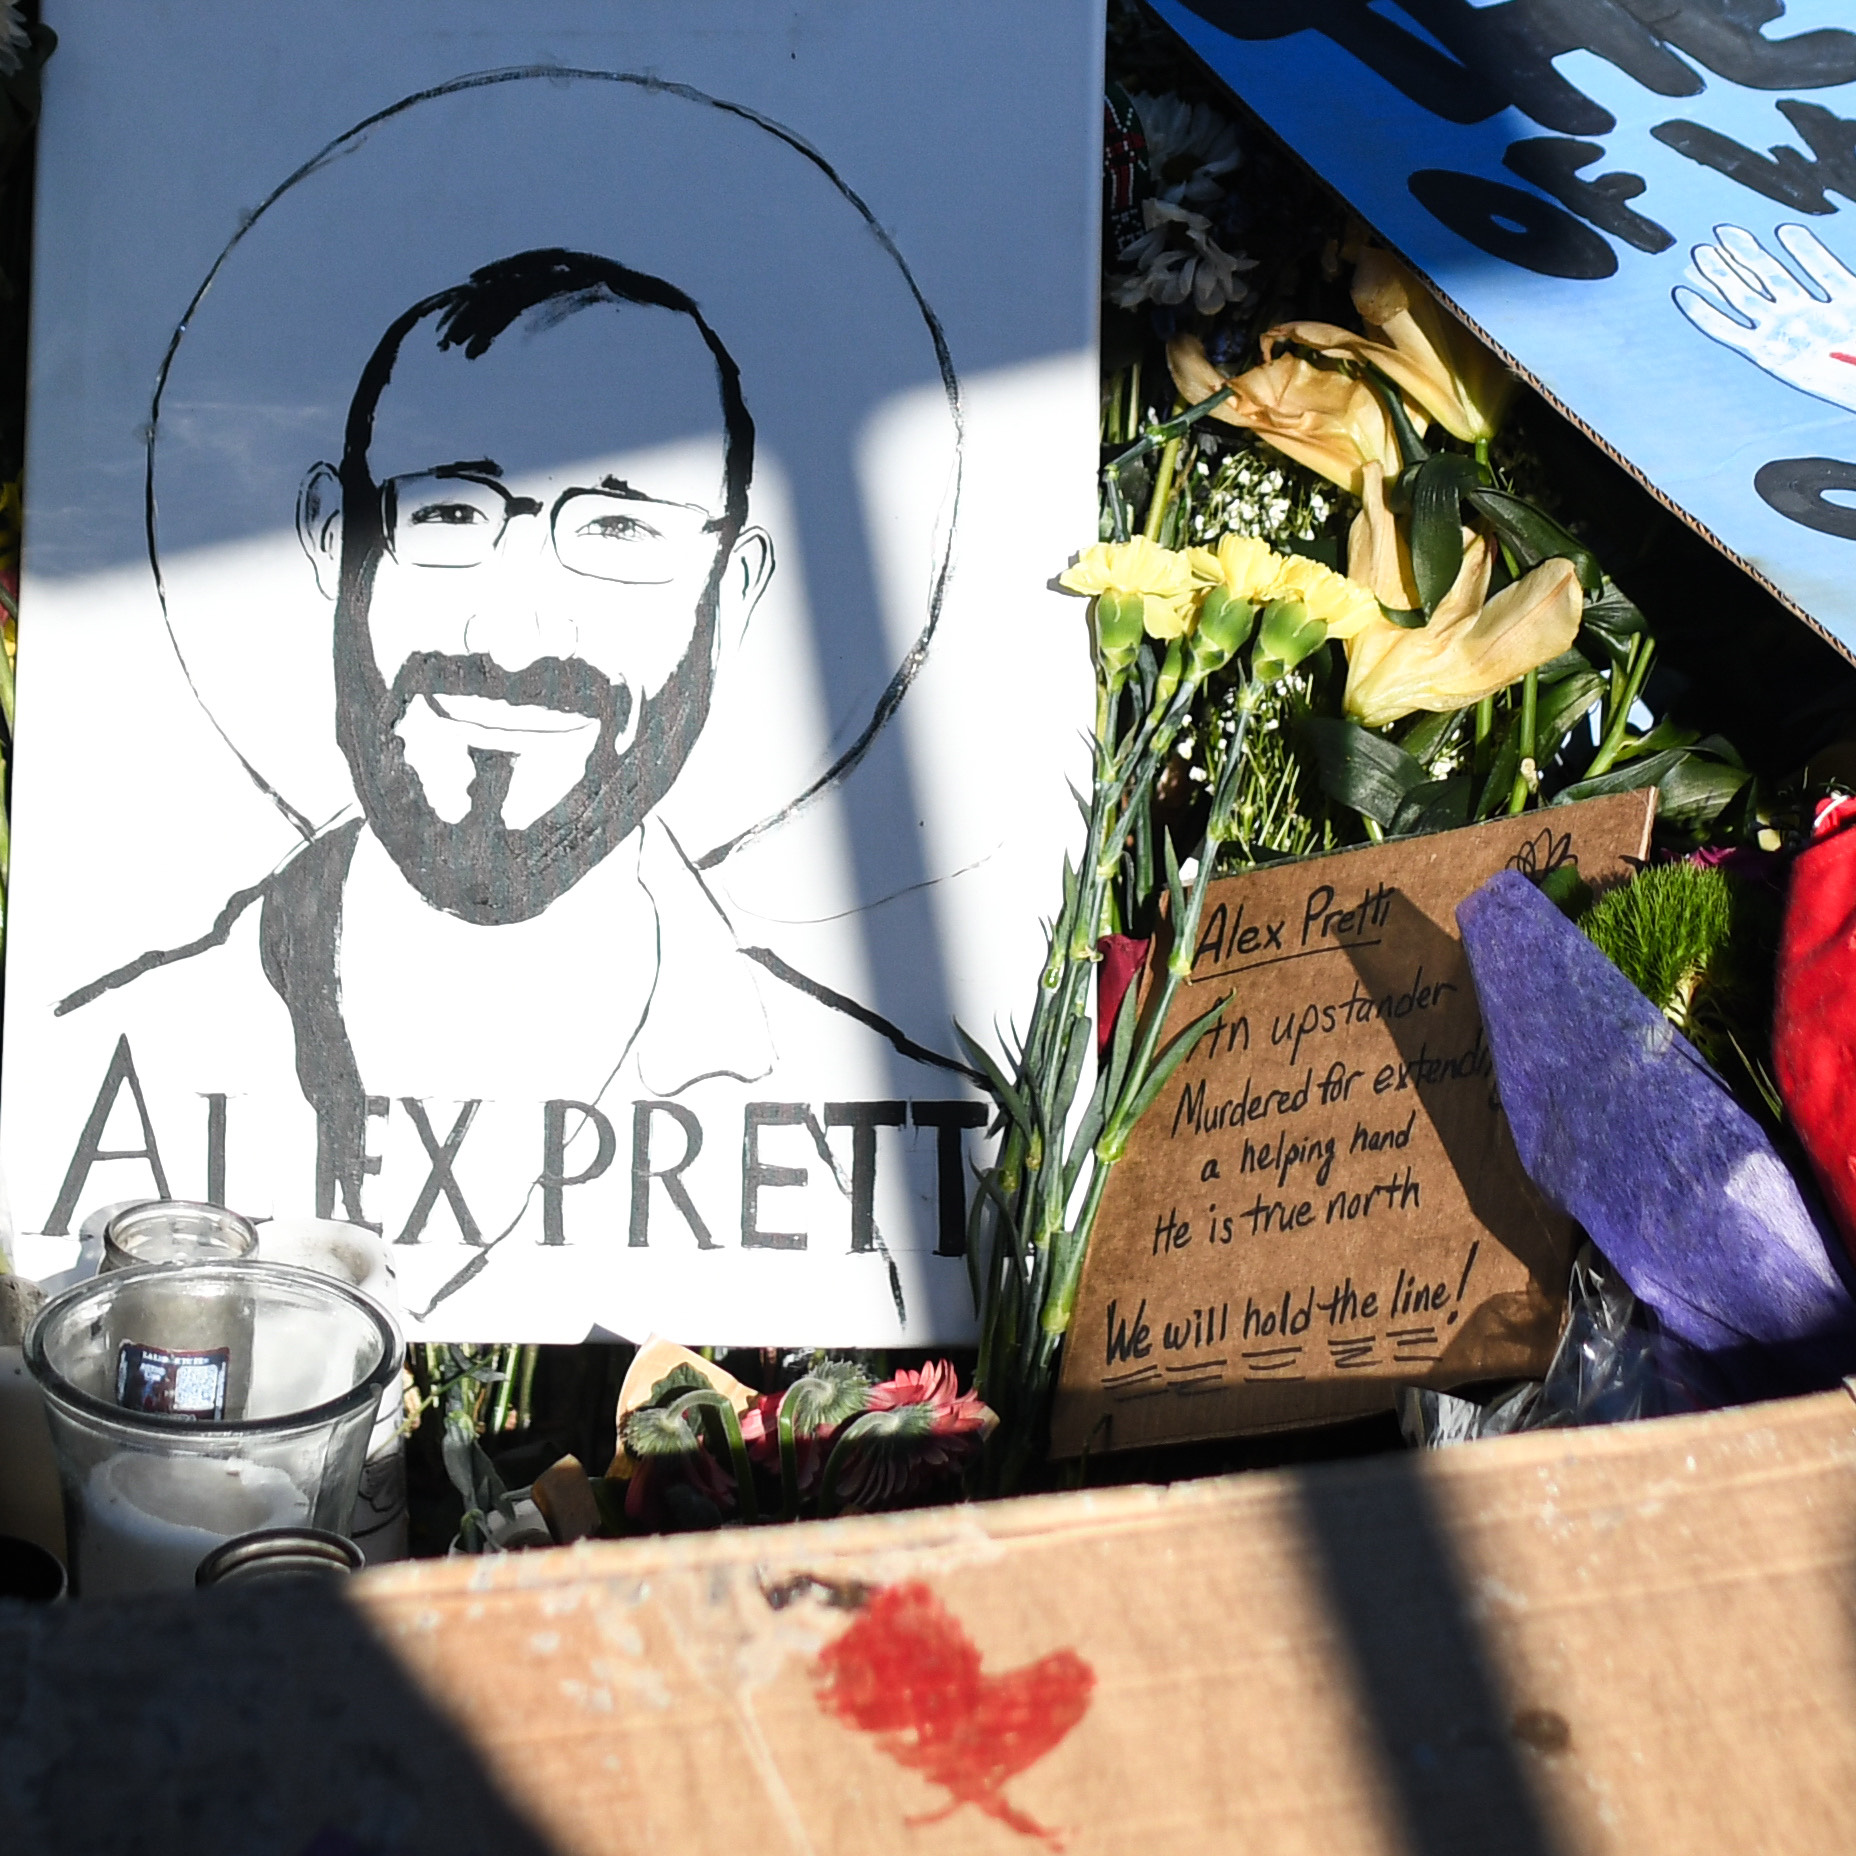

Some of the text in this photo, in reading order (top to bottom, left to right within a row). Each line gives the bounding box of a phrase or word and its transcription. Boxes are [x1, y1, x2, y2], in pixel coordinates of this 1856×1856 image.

[1406, 134, 1677, 280] OF
[1190, 882, 1399, 972] Alex Pretti
[1271, 965, 1458, 1066] upstander
[24, 1032, 496, 1248] ALEX
[1171, 1068, 1312, 1140] Murdered
[1319, 1061, 1366, 1103] for
[1200, 1109, 1416, 1187] a helping hand
[1151, 1166, 1420, 1257] He is true north
[1104, 1240, 1480, 1366] We will hold the line!
